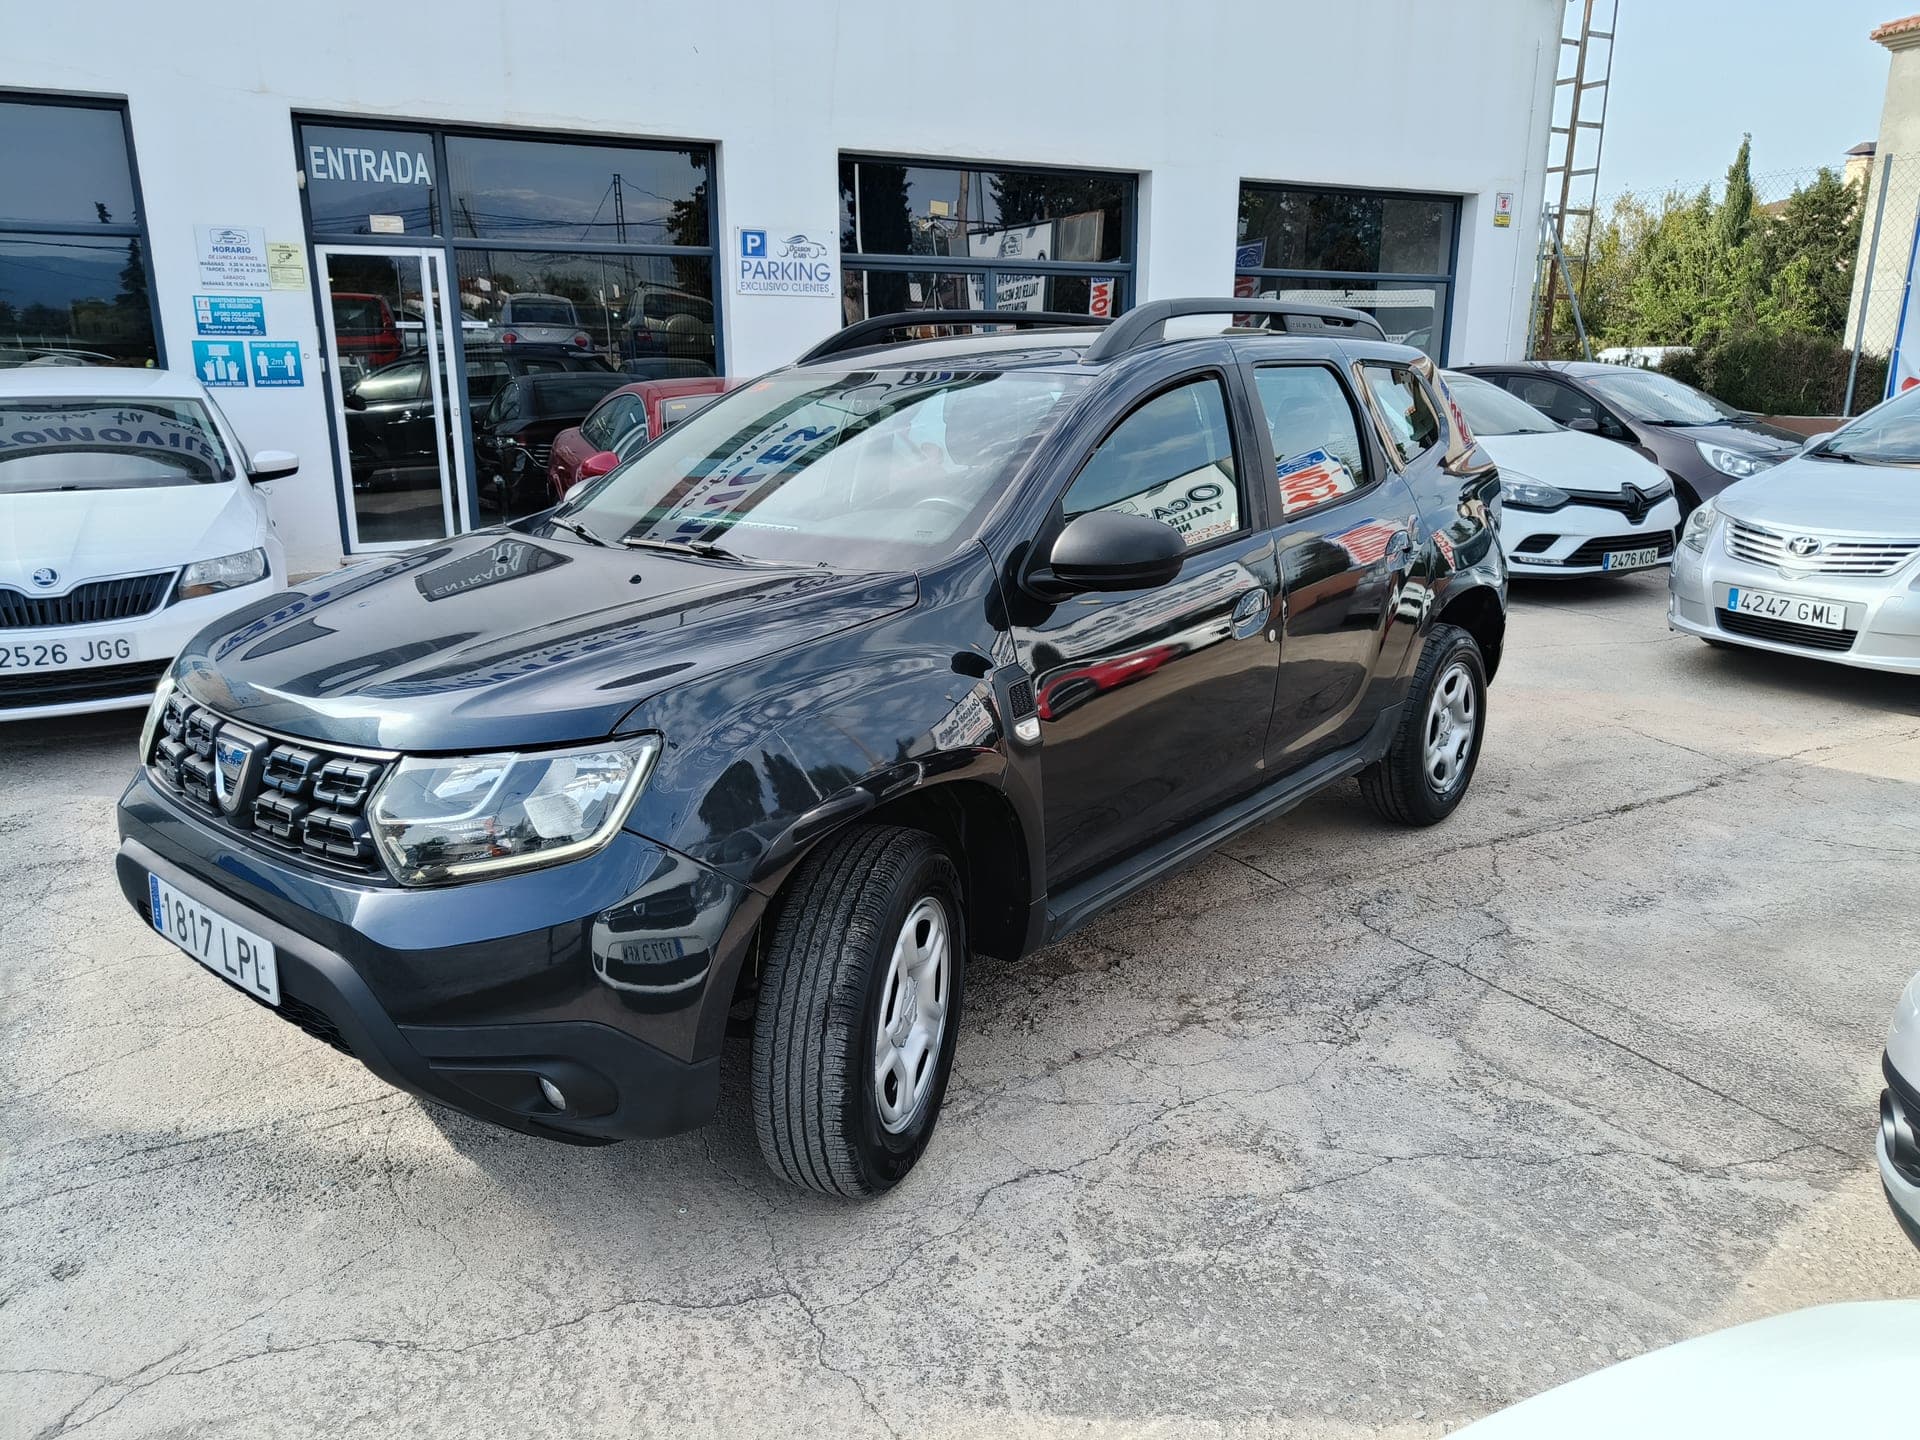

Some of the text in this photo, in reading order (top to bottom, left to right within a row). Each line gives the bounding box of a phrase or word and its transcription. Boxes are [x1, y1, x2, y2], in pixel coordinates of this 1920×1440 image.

[309, 145, 433, 186] ENTRADA
[212, 246, 251, 254] HORARIO
[746, 234, 761, 255] P
[741, 260, 831, 282] PARKING
[740, 281, 830, 293] EXCLUSIVO CLIENTES
[1611, 550, 1656, 568] 2476 KCG
[1741, 593, 1837, 626] 4247 GML
[0, 638, 131, 668] 2526 JGG
[164, 892, 271, 995] 1817 LPL
